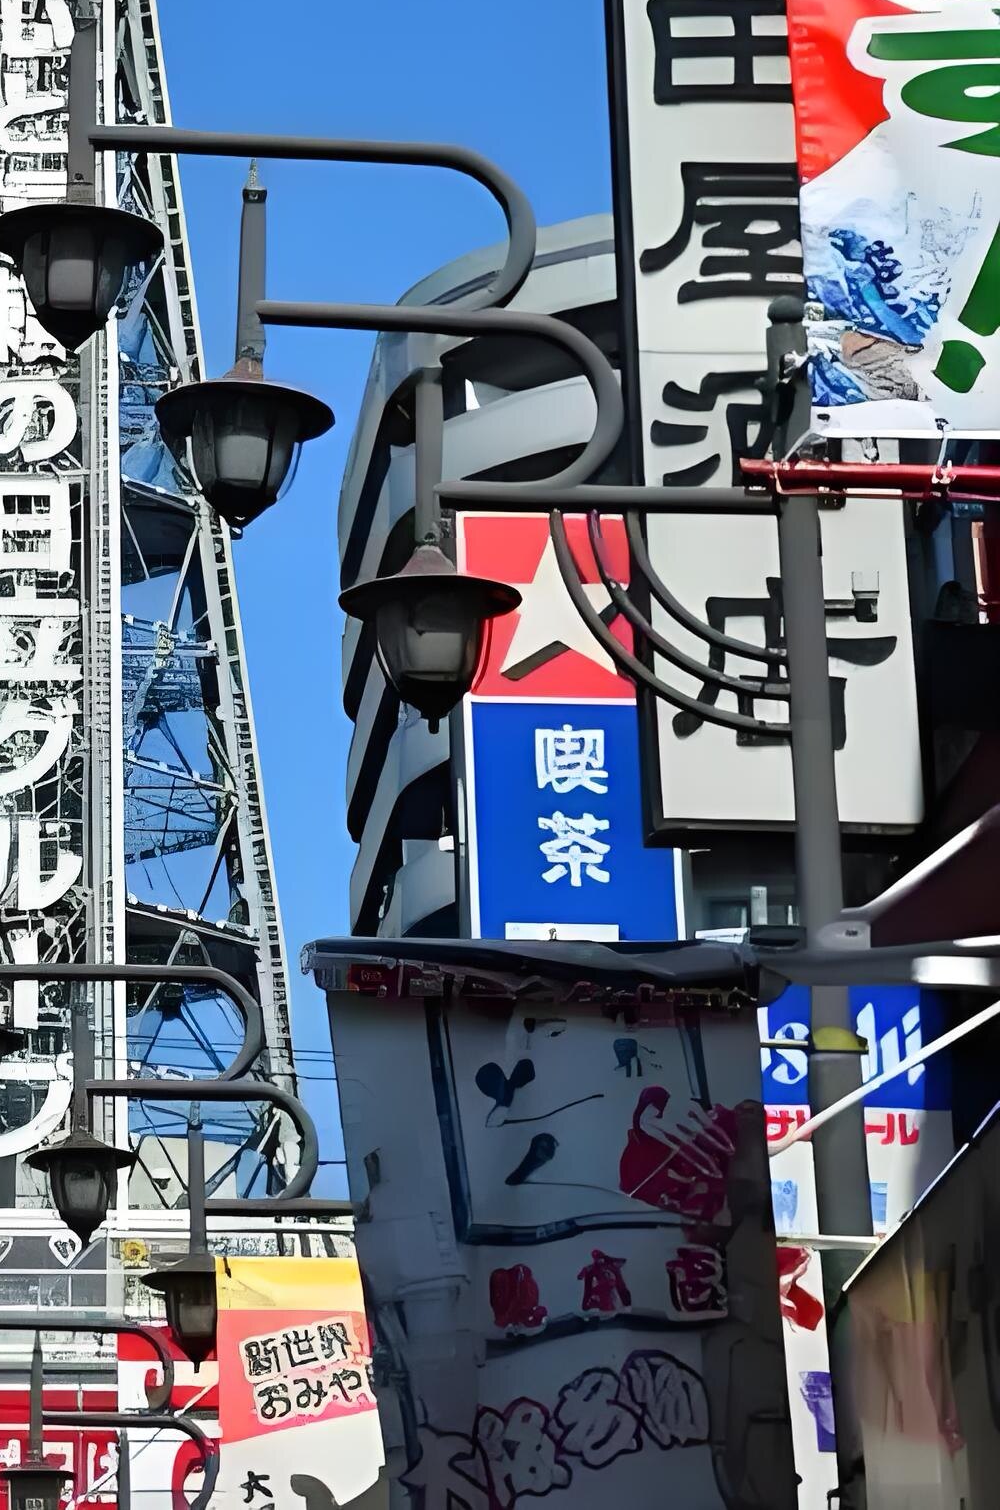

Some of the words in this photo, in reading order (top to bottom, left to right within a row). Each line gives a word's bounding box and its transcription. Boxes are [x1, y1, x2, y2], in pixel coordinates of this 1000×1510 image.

[534, 723, 611, 887] 喫茶
[244, 1322, 351, 1377] 新世界
